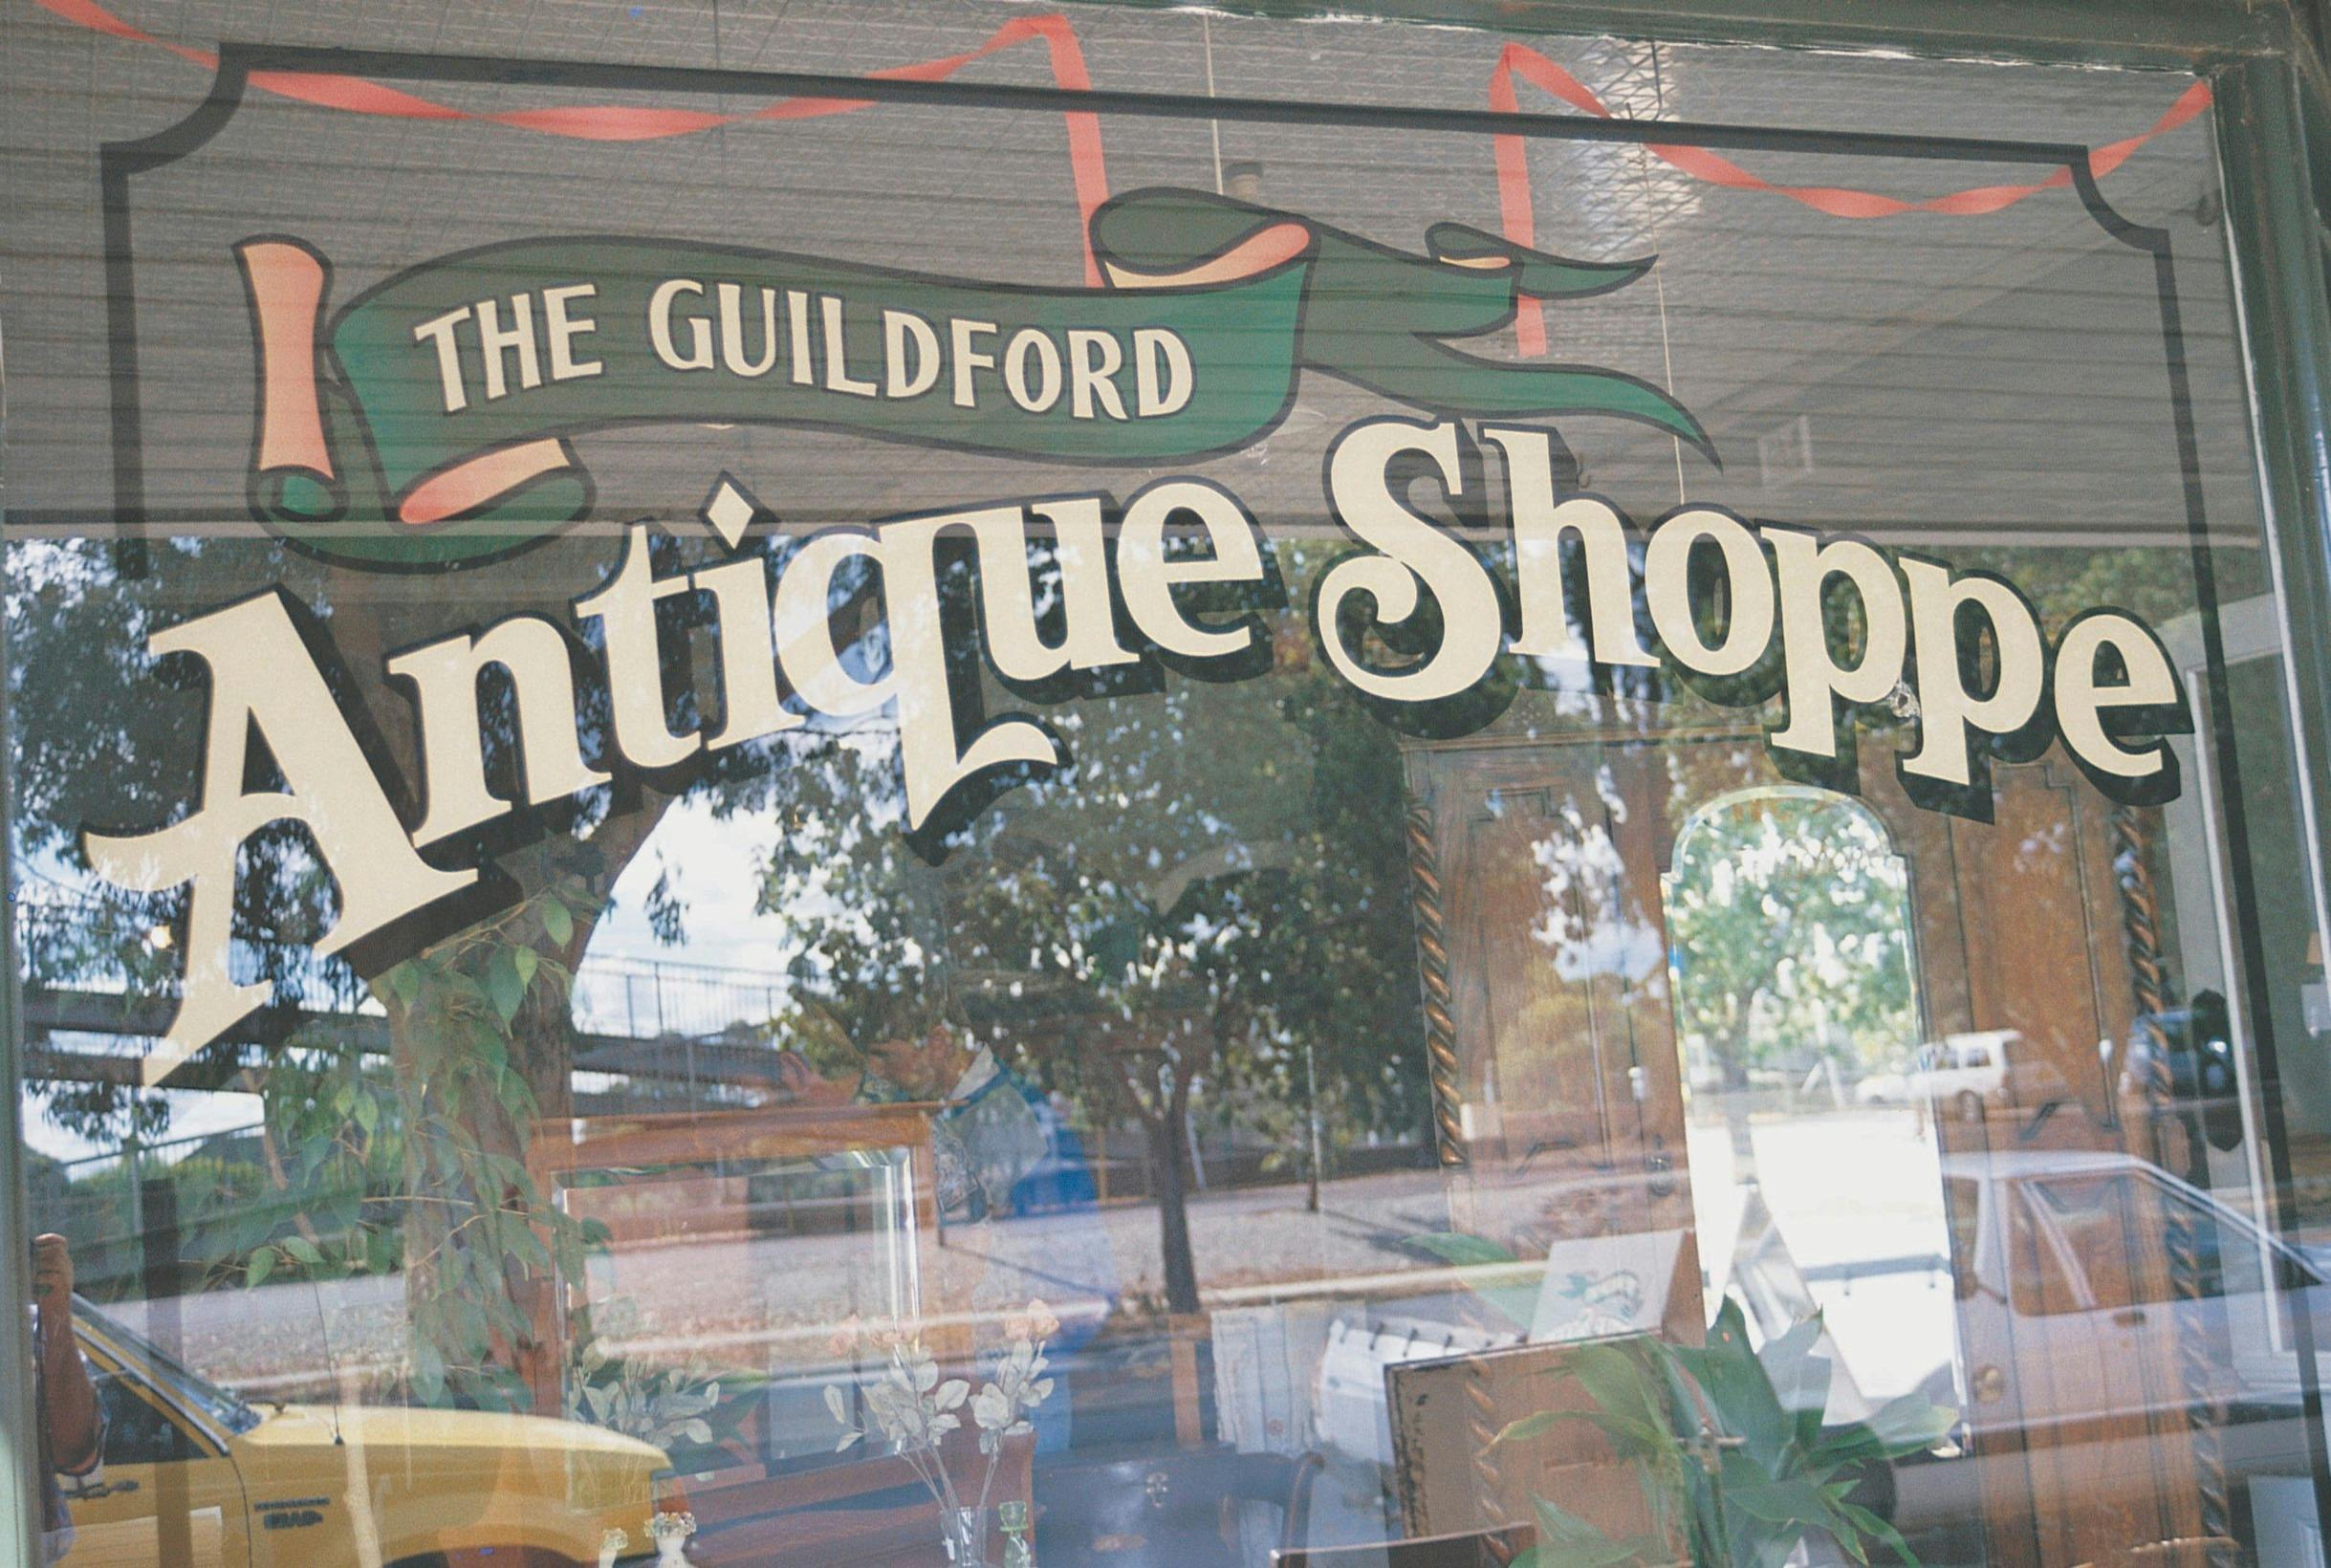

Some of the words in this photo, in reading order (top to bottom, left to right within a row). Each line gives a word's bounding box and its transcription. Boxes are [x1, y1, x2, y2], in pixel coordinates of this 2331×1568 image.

[415, 284, 603, 413] THE
[649, 279, 1194, 421] GUILDFORD
[83, 479, 1264, 1087] Antique
[1317, 422, 2177, 785] Shoppe
